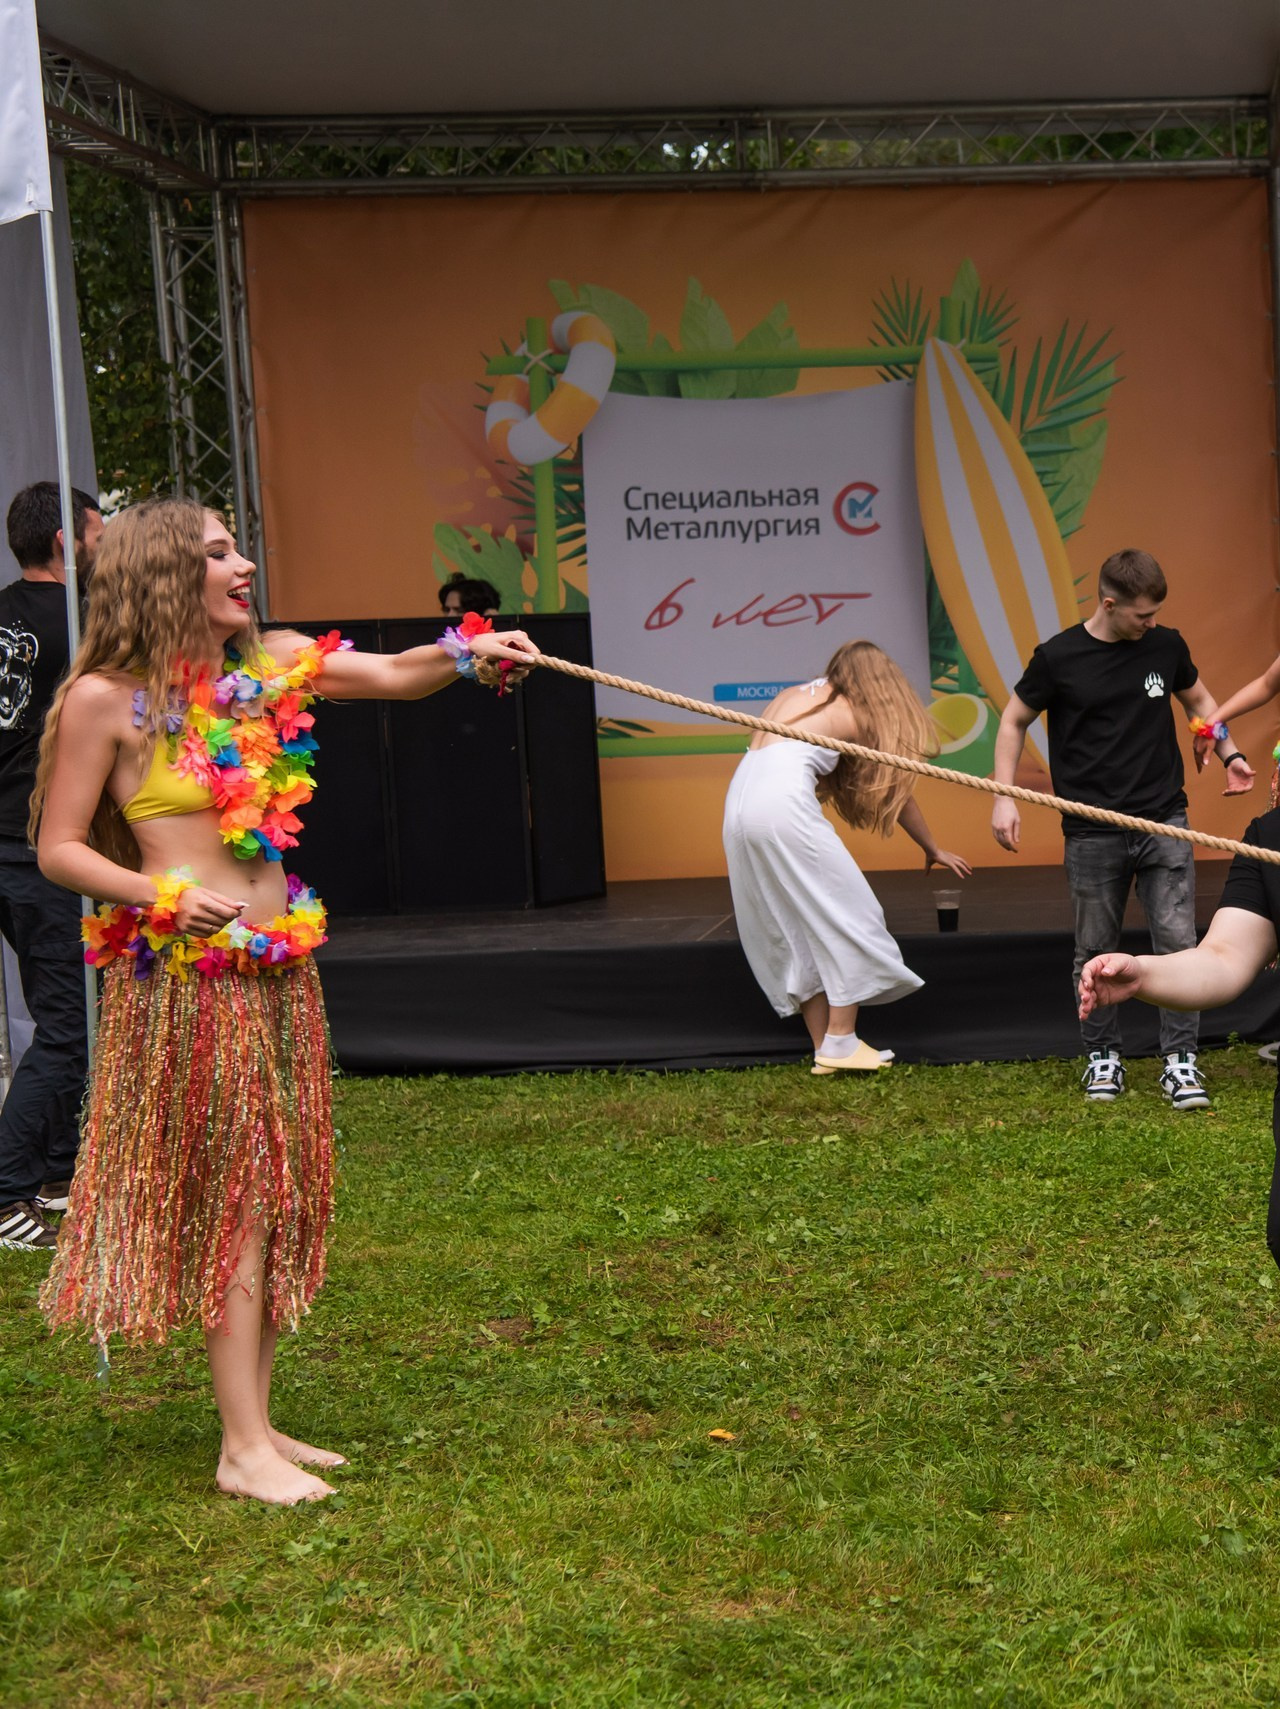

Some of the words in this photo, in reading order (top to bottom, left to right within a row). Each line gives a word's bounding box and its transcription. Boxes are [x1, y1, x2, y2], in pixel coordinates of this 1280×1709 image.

[624, 486, 819, 513] Специальная
[626, 516, 820, 544] Металлургия
[644, 577, 696, 631] 6
[712, 593, 872, 630] лет
[737, 686, 784, 698] МОСКВ
